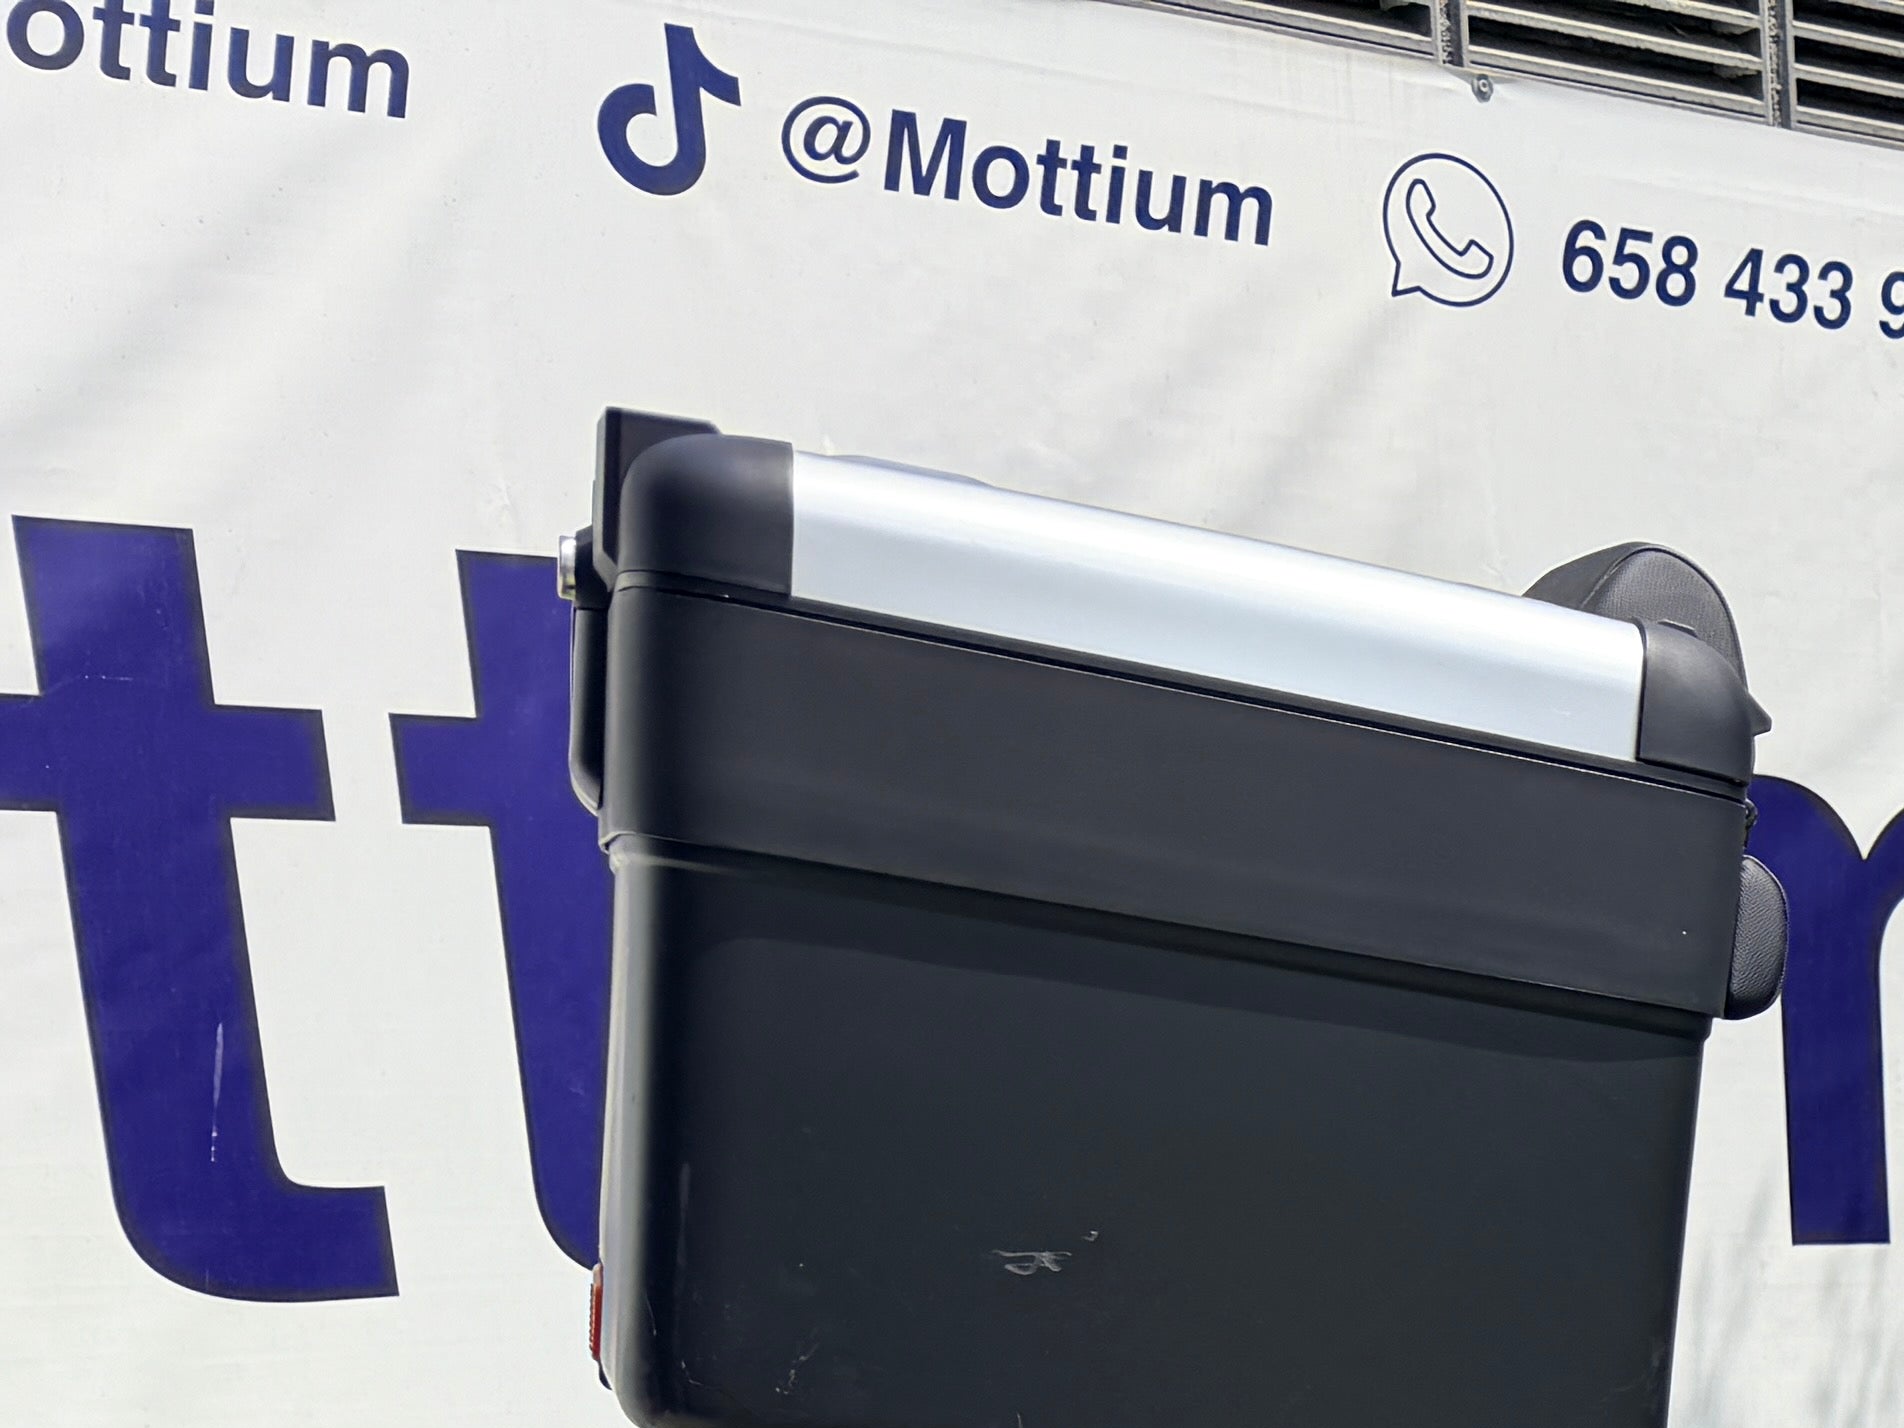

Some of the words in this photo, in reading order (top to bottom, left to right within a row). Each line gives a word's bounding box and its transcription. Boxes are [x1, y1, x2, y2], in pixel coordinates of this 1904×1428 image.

[5, 0, 410, 118] ottium
[781, 95, 1274, 247] @Mottium
[1561, 219, 1698, 307] 658
[1724, 251, 1854, 331] 433
